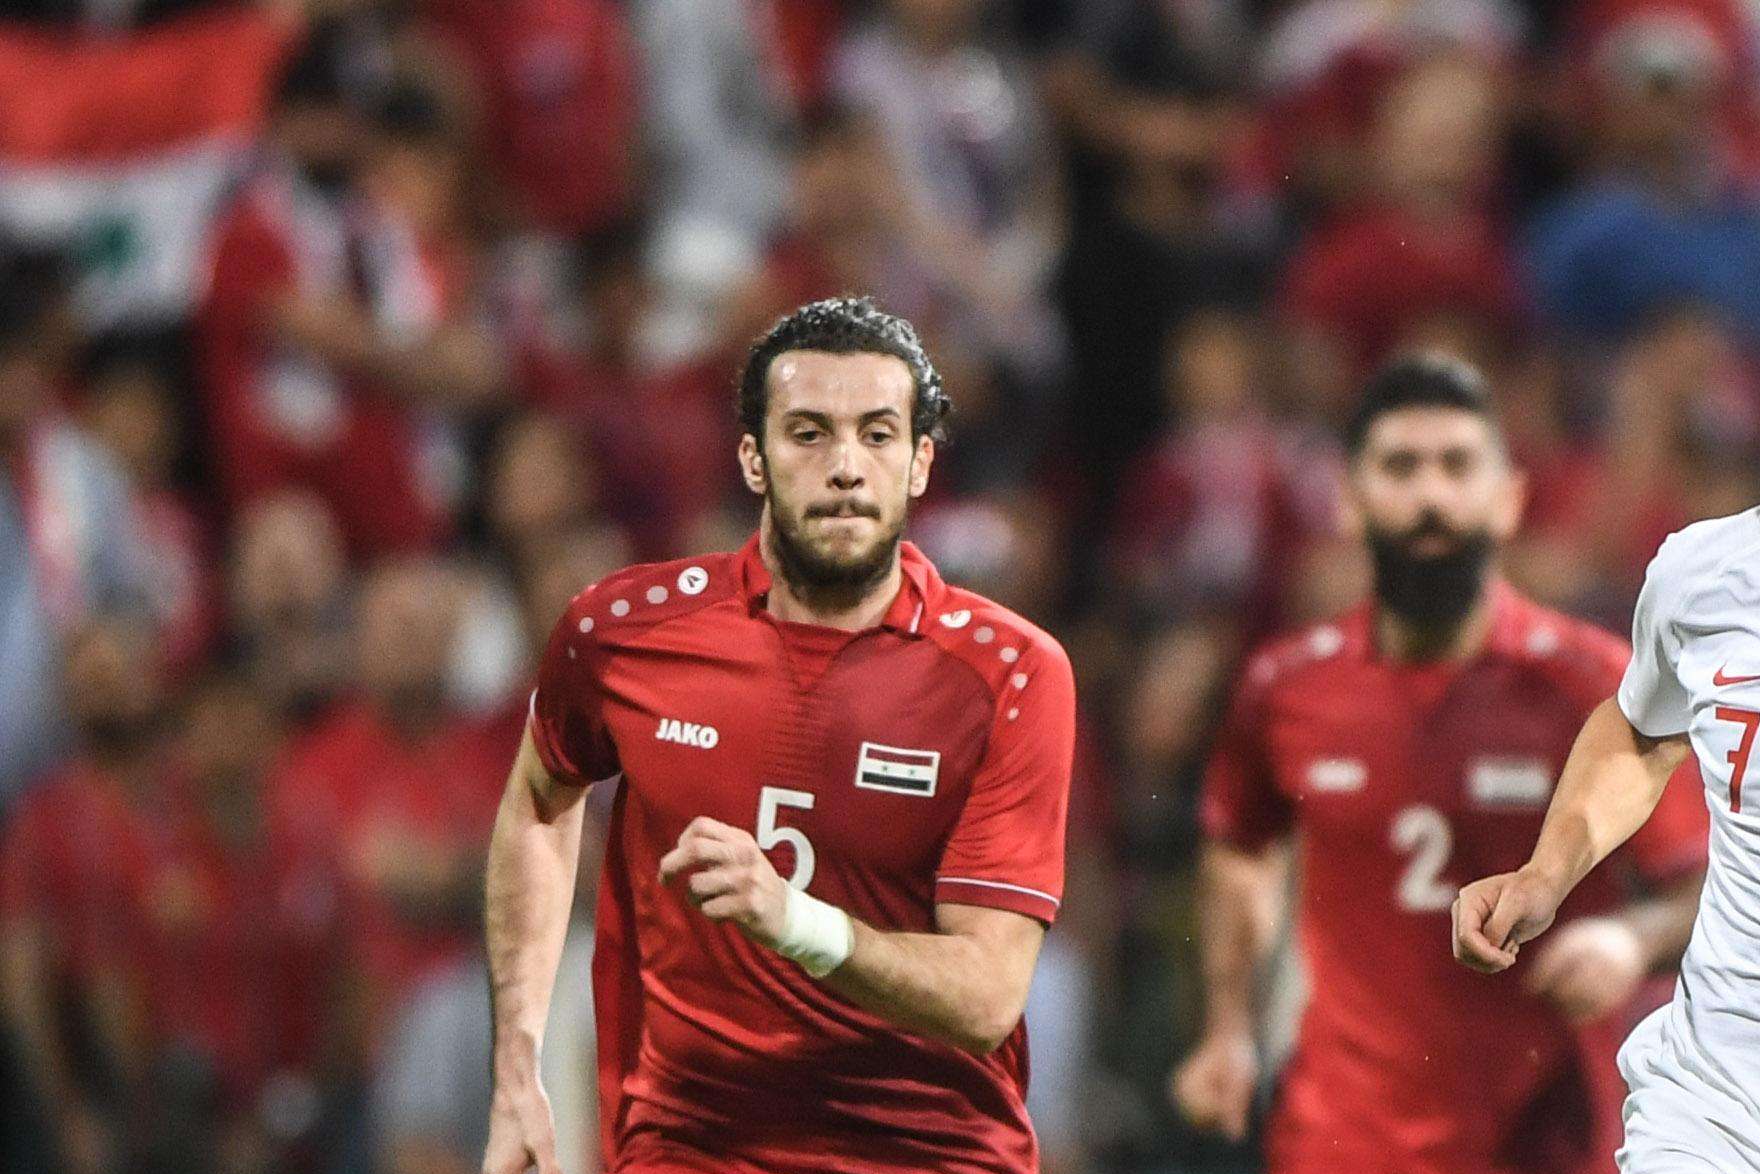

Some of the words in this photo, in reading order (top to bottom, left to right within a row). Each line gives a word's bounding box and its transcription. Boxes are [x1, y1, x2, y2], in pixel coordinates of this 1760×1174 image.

[655, 717, 719, 750] JAKO
[755, 785, 817, 893] 5
[1391, 805, 1456, 911] 2
